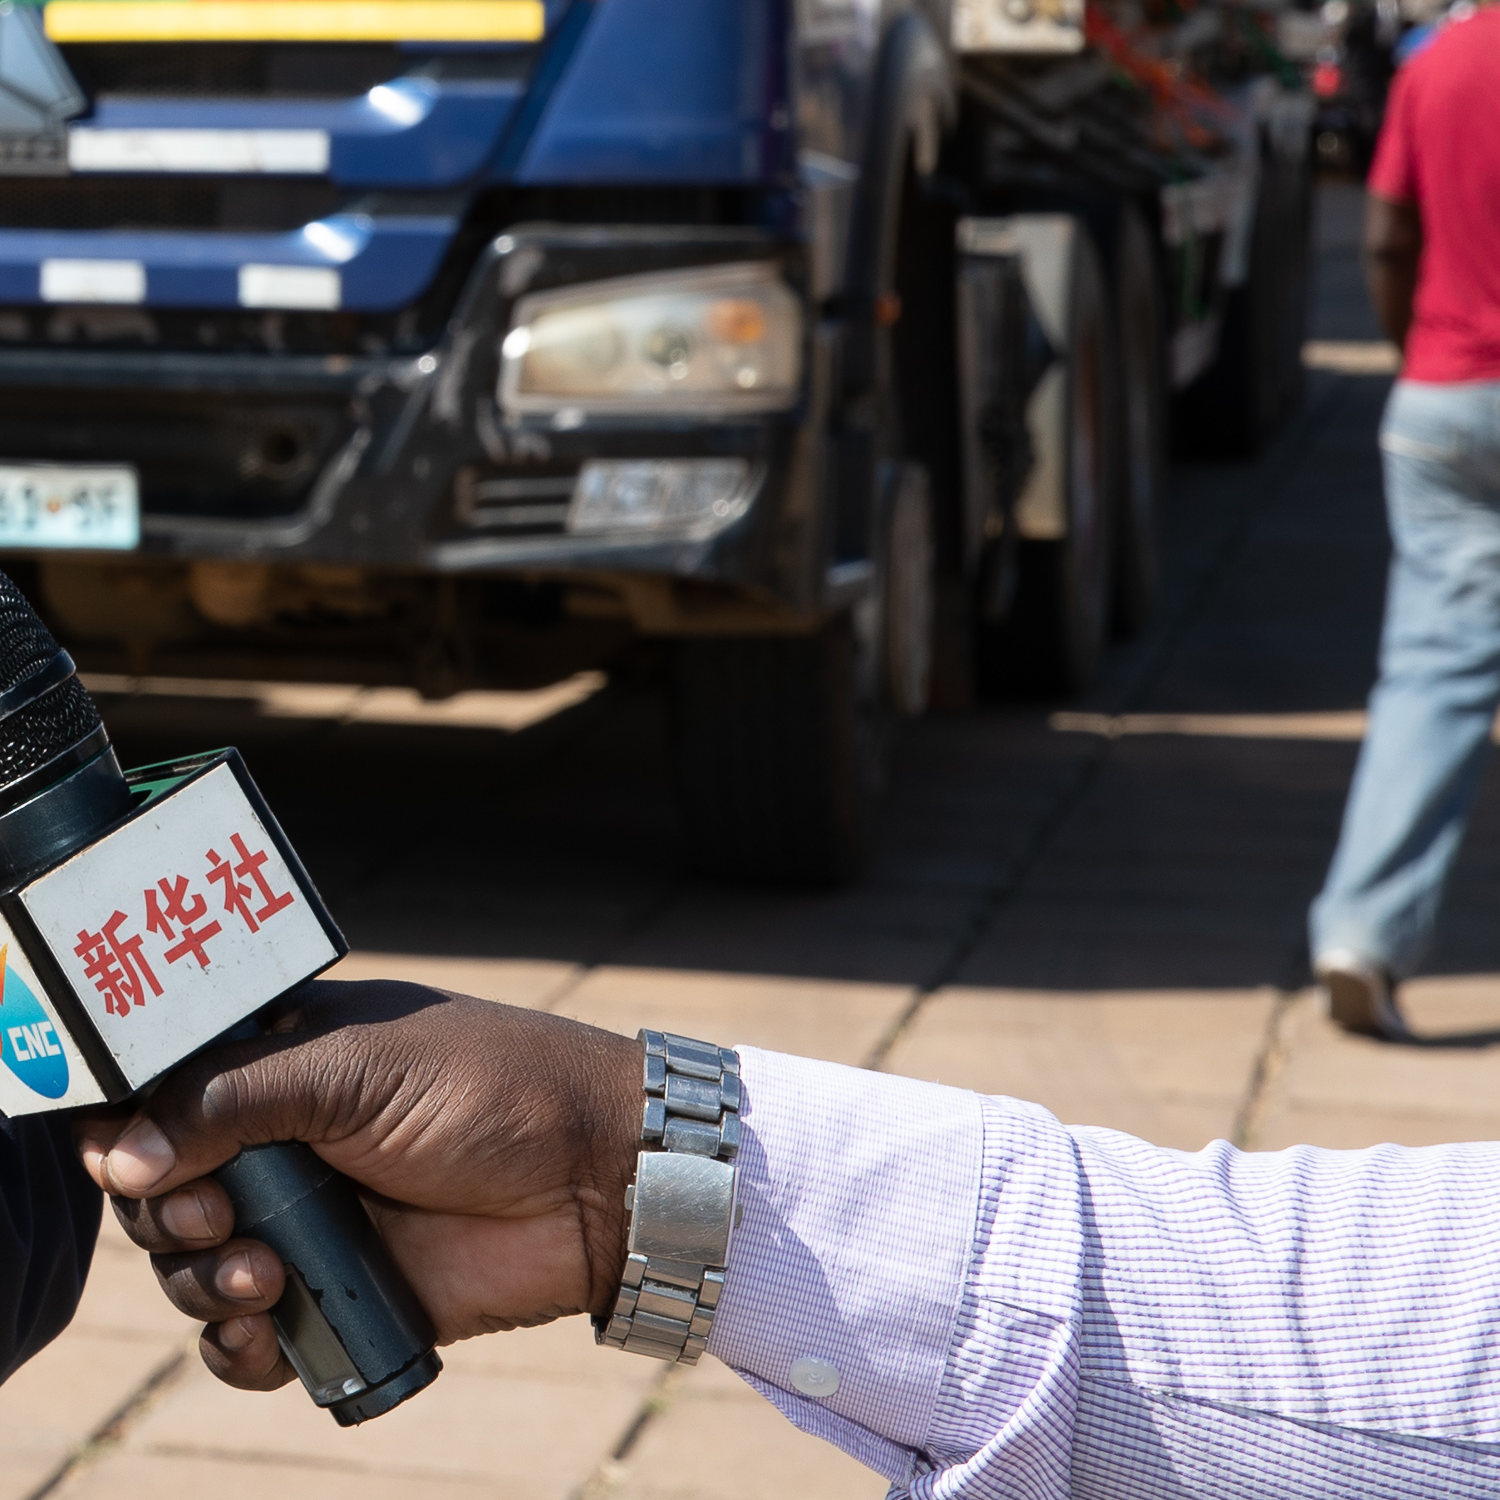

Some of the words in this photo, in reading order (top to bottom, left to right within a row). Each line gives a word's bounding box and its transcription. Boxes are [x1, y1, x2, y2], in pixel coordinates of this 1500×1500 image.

[73, 833, 295, 1018] 新华社
[7, 1021, 61, 1062] CNC
